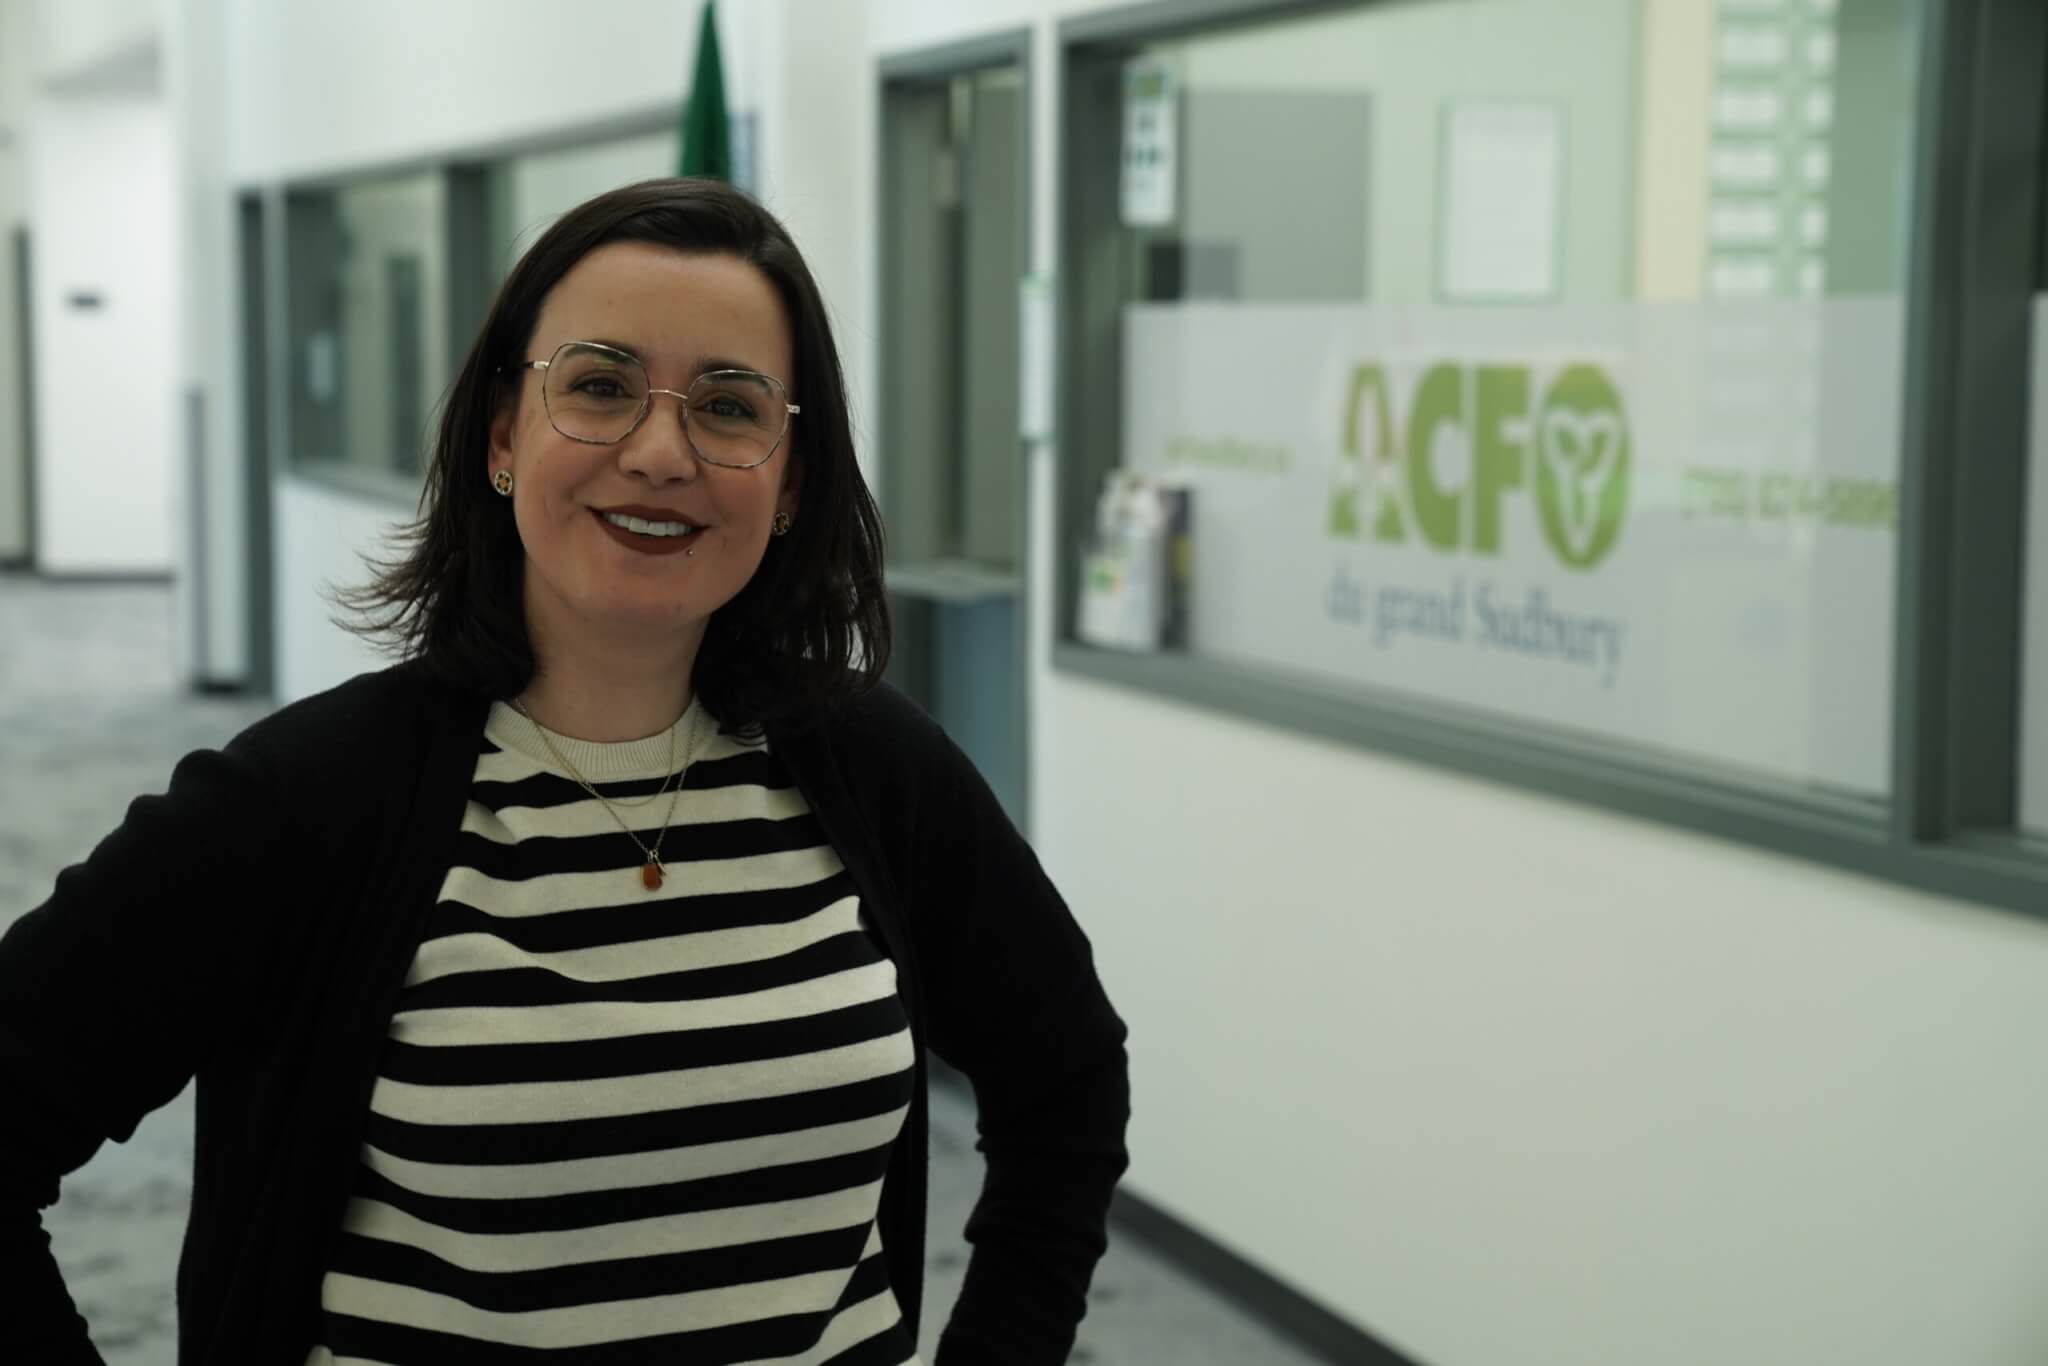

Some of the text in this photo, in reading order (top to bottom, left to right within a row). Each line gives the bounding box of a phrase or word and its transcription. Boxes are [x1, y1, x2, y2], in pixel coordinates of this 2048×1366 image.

[1328, 361, 1632, 572] ACFO
[1326, 565, 1630, 687] du grand Sudbury
